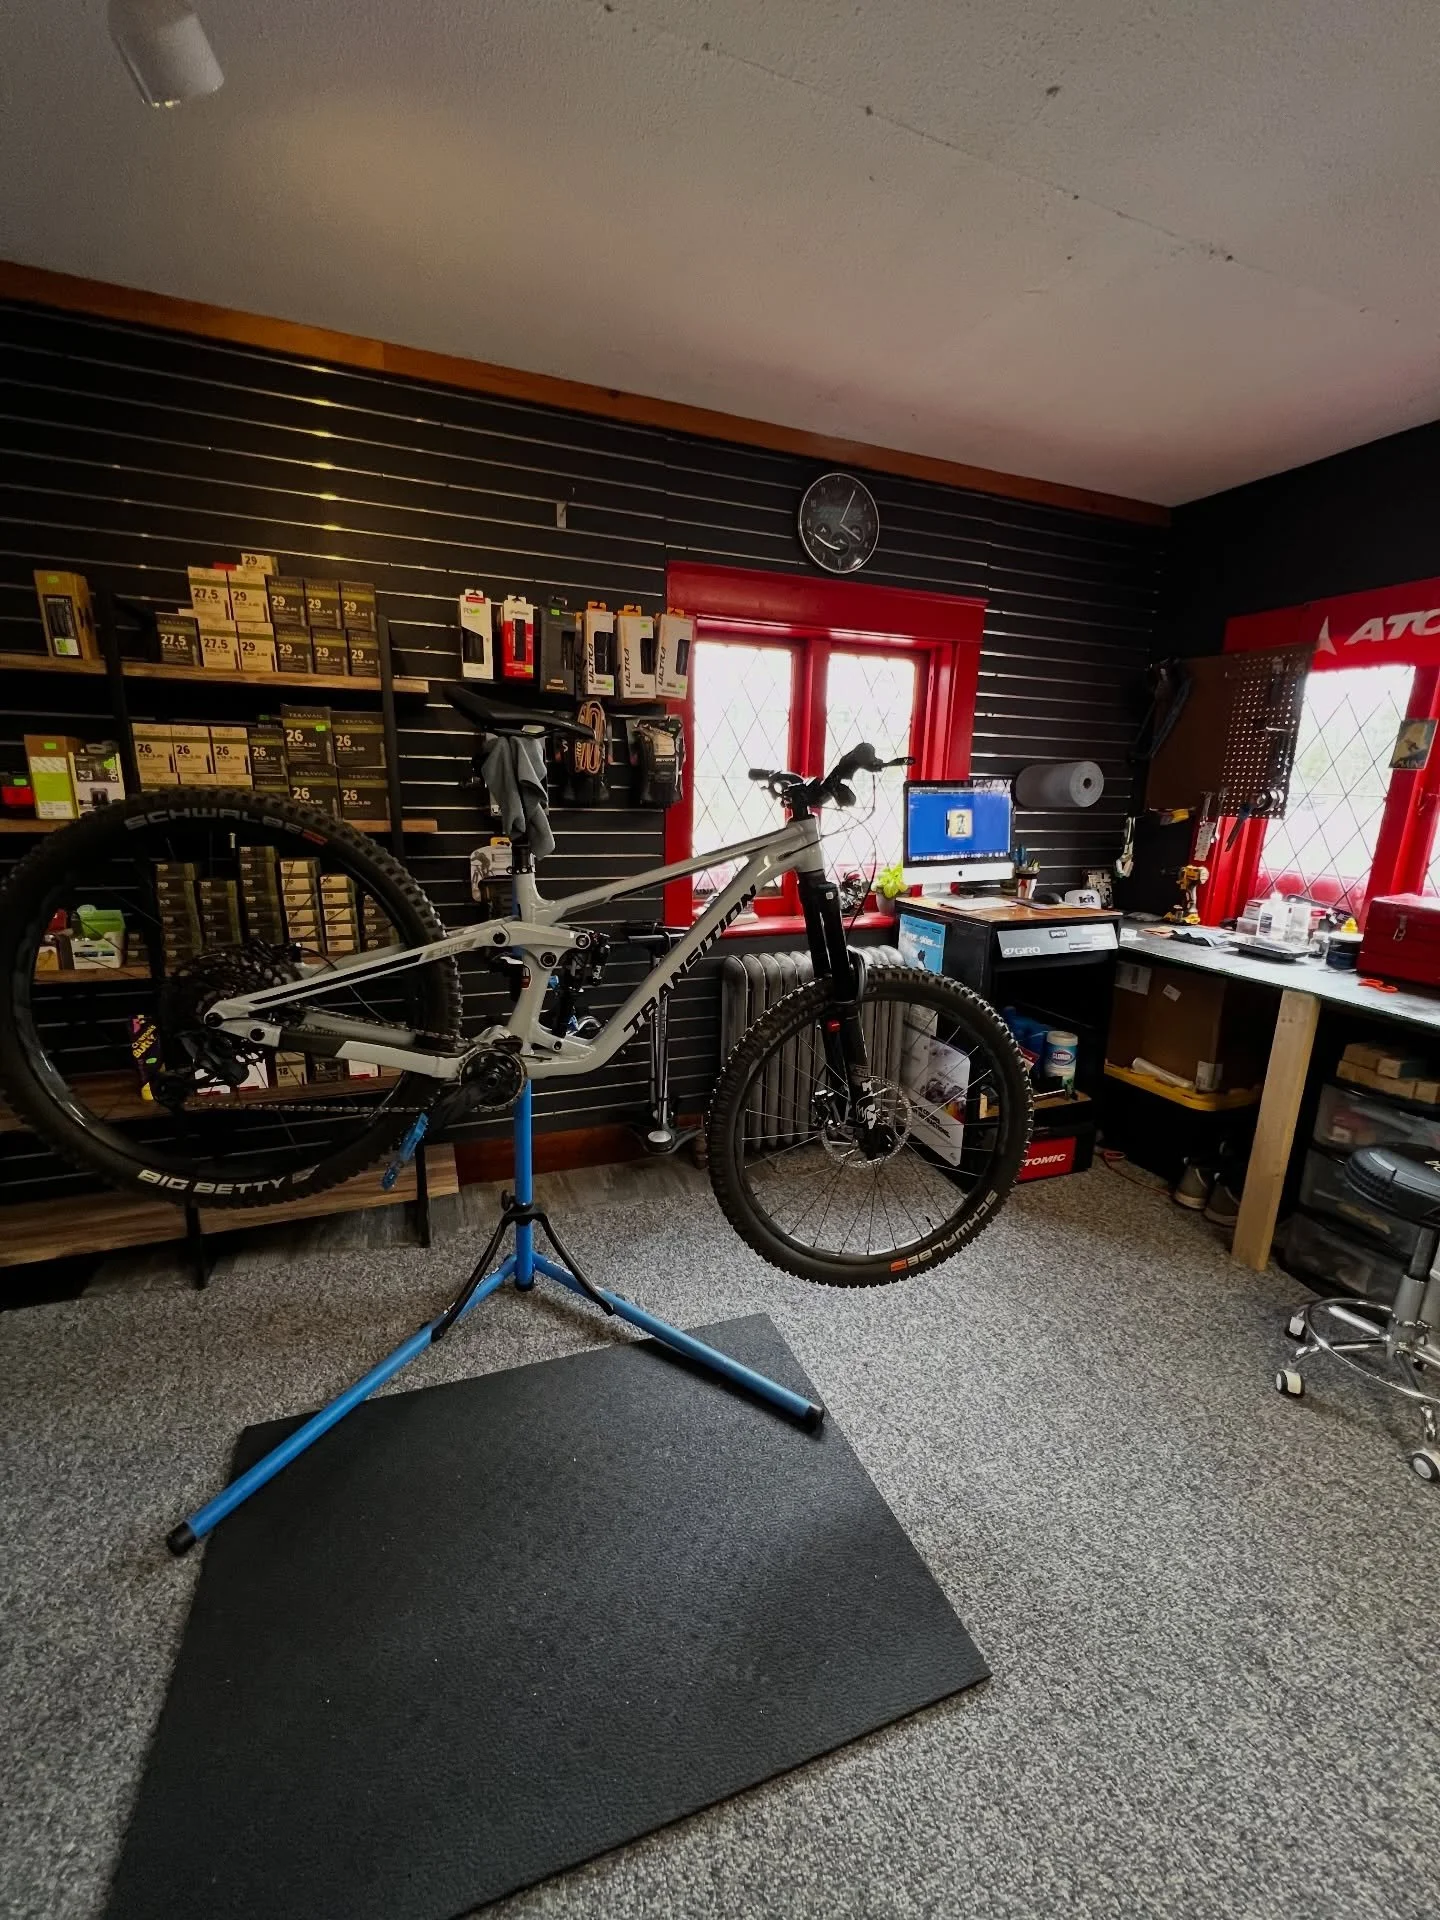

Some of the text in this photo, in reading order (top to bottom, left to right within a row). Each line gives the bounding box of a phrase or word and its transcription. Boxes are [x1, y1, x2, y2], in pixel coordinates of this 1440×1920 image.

[244, 556, 258, 565] 29
[193, 588, 218, 600] 27.5
[233, 591, 247, 602] 29
[271, 595, 286, 606] 29
[308, 598, 322, 609] 29
[344, 600, 357, 612] 29
[160, 633, 186, 646] 27.5
[203, 638, 228, 649] 27.5
[242, 642, 256, 652] 29
[278, 644, 293, 654] 29
[316, 646, 329, 658] 29
[351, 649, 364, 660] 29
[658, 646, 667, 686] ULTRA
[286, 729, 304, 742] 26
[335, 734, 352, 747] 26
[137, 744, 152, 754] 26
[176, 744, 190, 754] 26
[216, 746, 230, 756] 26
[251, 746, 267, 757] 26
[292, 786, 310, 800] 26
[342, 789, 358, 801] 26
[124, 807, 304, 834] SCHWALBE
[1014, 946, 1041, 954] GIRO
[623, 884, 757, 1034] TRANSITION
[1021, 1153, 1067, 1167] TOMIC
[137, 1168, 286, 1195] BIG BETTY
[907, 1189, 1000, 1267] SCHWALBE
